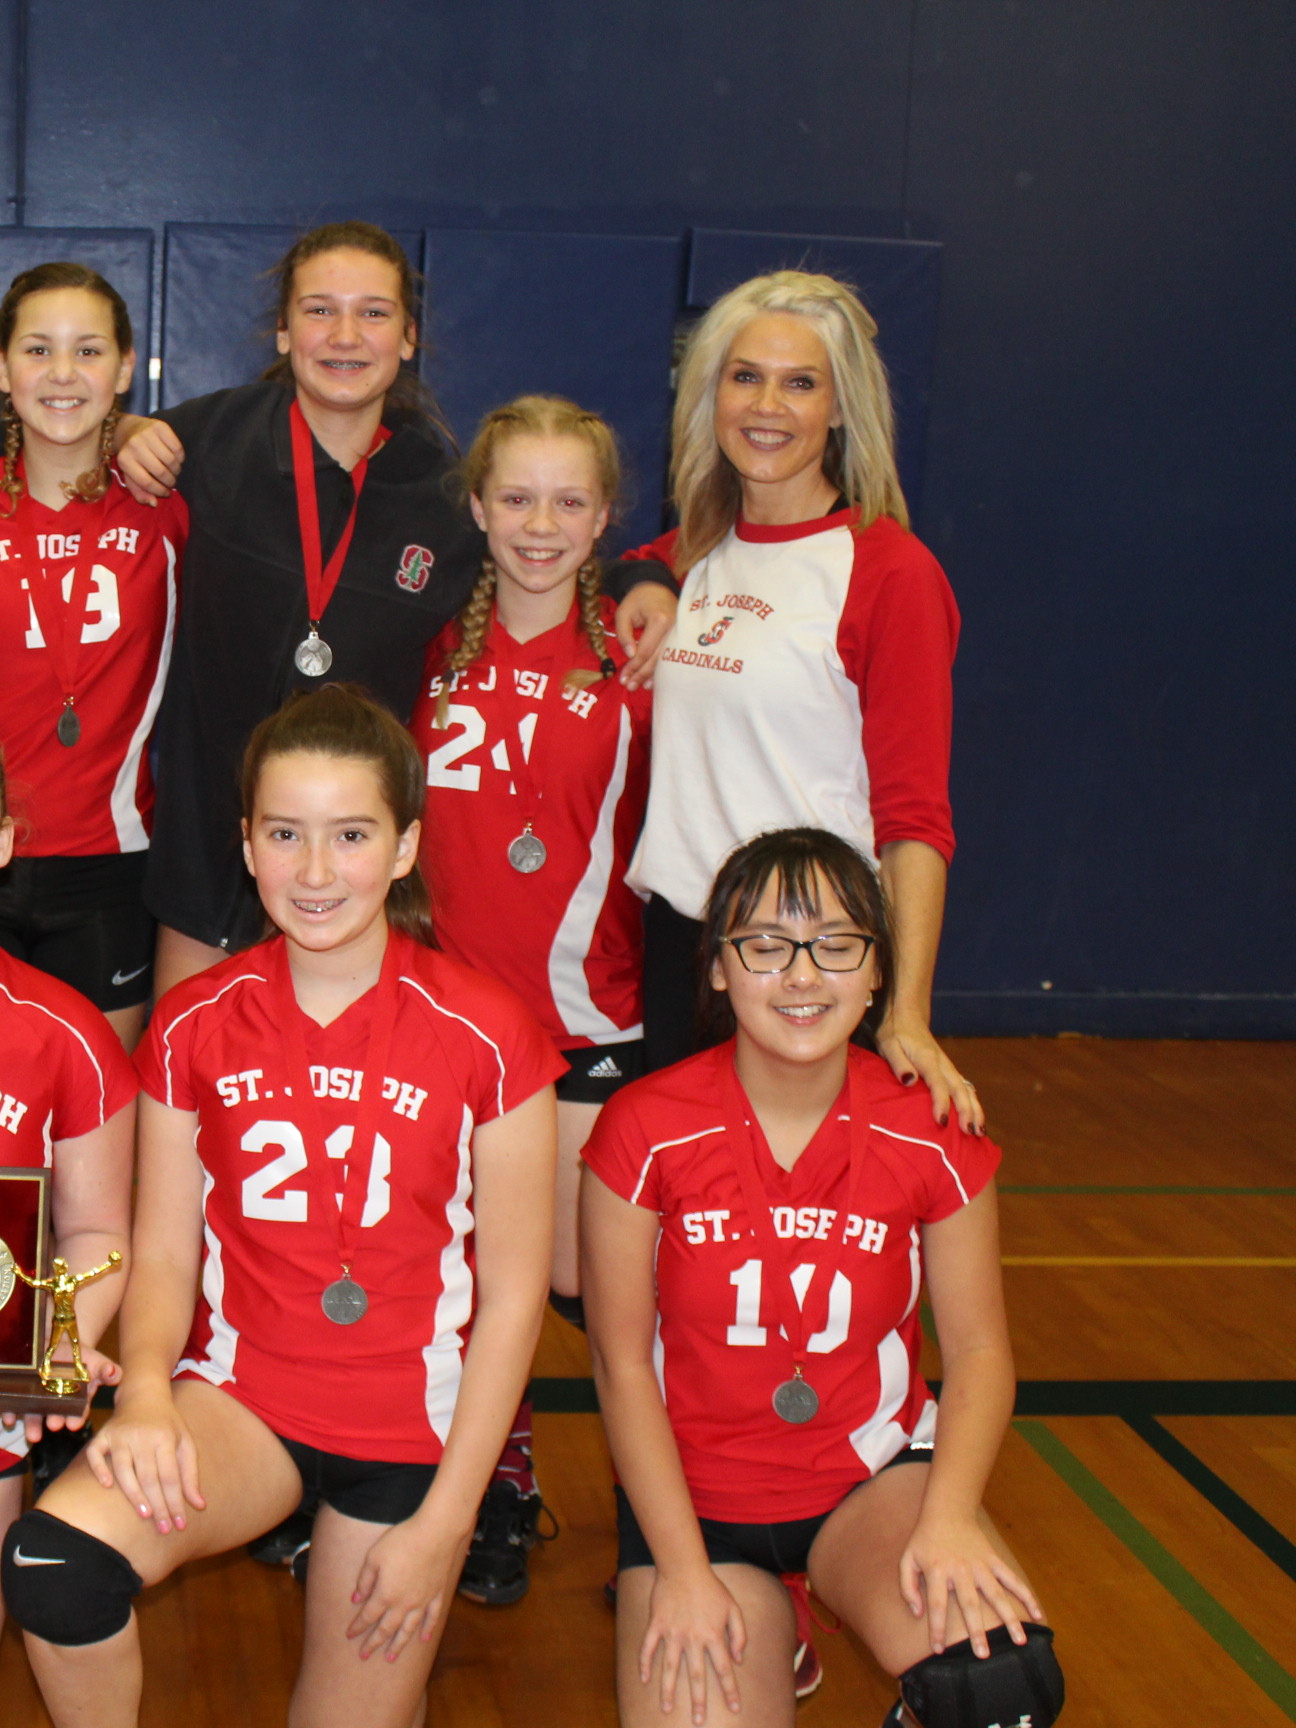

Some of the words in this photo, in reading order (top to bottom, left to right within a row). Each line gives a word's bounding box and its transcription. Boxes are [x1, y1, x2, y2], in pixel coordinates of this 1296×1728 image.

[716, 594, 775, 620] JOSEPH
[662, 647, 743, 674] CARDINALS
[216, 1068, 273, 1108] ST.
[683, 1210, 741, 1245] ST.
[749, 1206, 889, 1255] OSEPH
